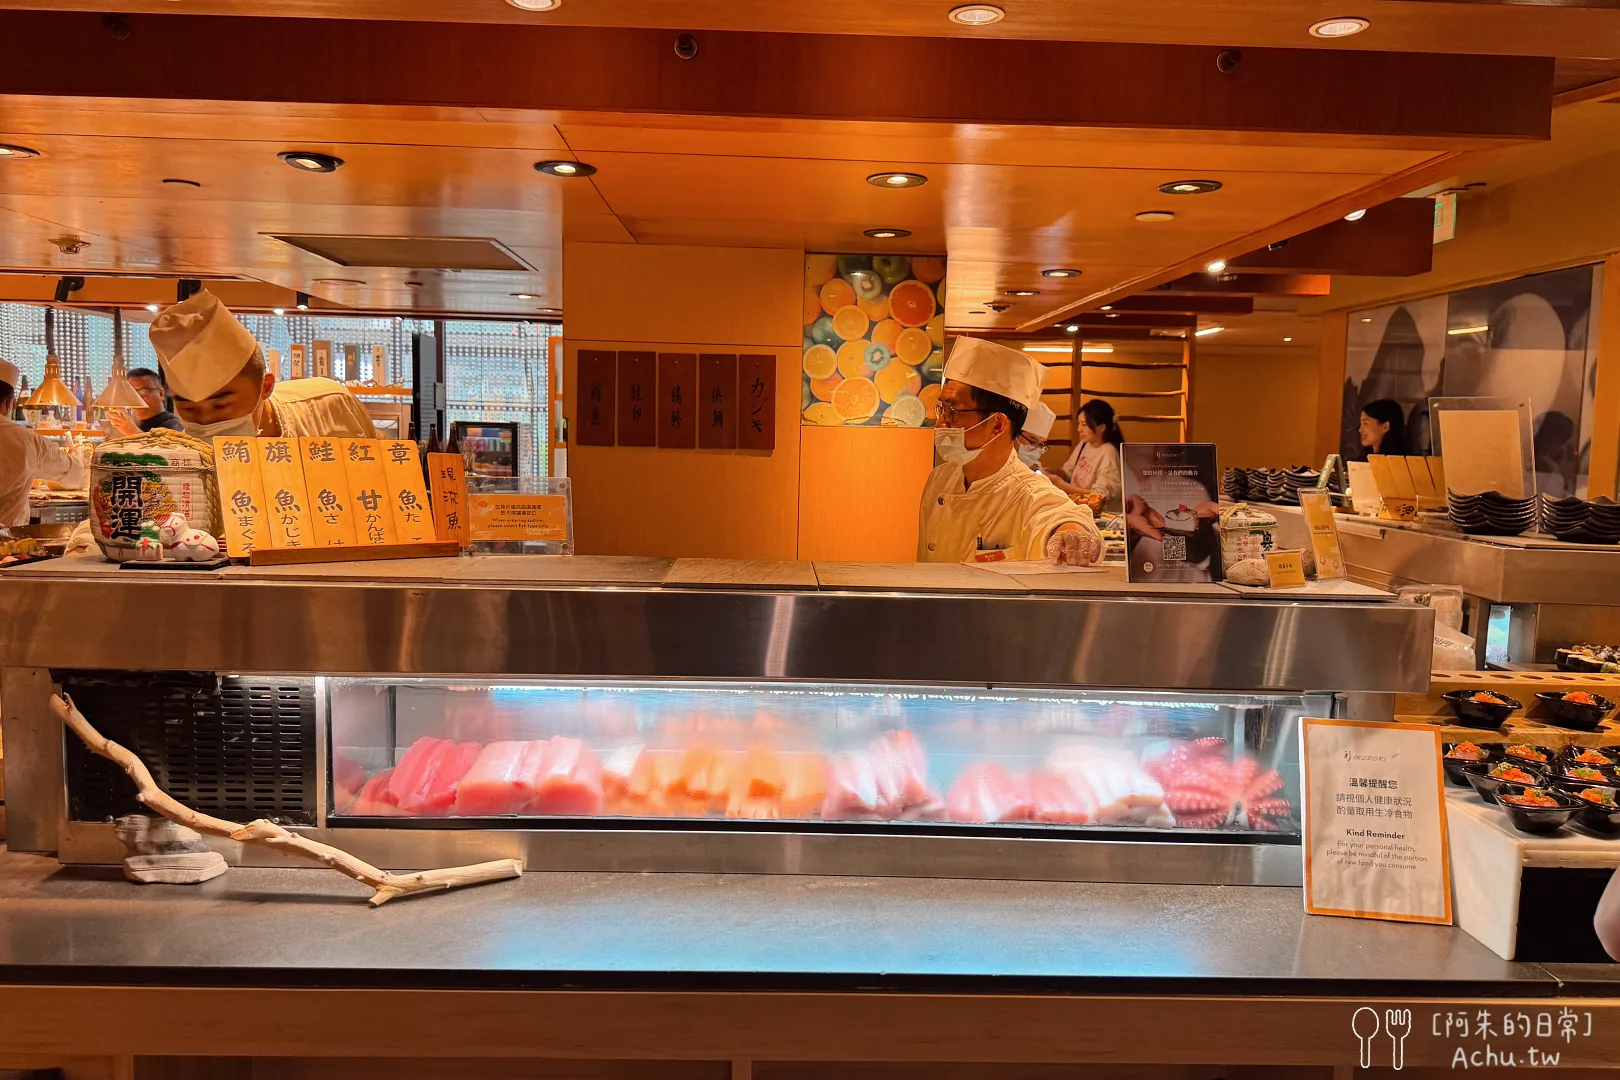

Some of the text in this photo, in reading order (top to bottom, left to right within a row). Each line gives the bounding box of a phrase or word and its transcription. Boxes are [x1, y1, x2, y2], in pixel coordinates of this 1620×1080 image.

[750, 377, 769, 433] カジキ
[110, 476, 143, 540] 開運
[1336, 793, 1412, 806] 請視個人健康狀況
[1337, 806, 1413, 819] 酌量取用生冷食物
[1346, 829, 1405, 839] Kind Reminder
[1358, 859, 1373, 867] food
[1403, 854, 1428, 862] portion
